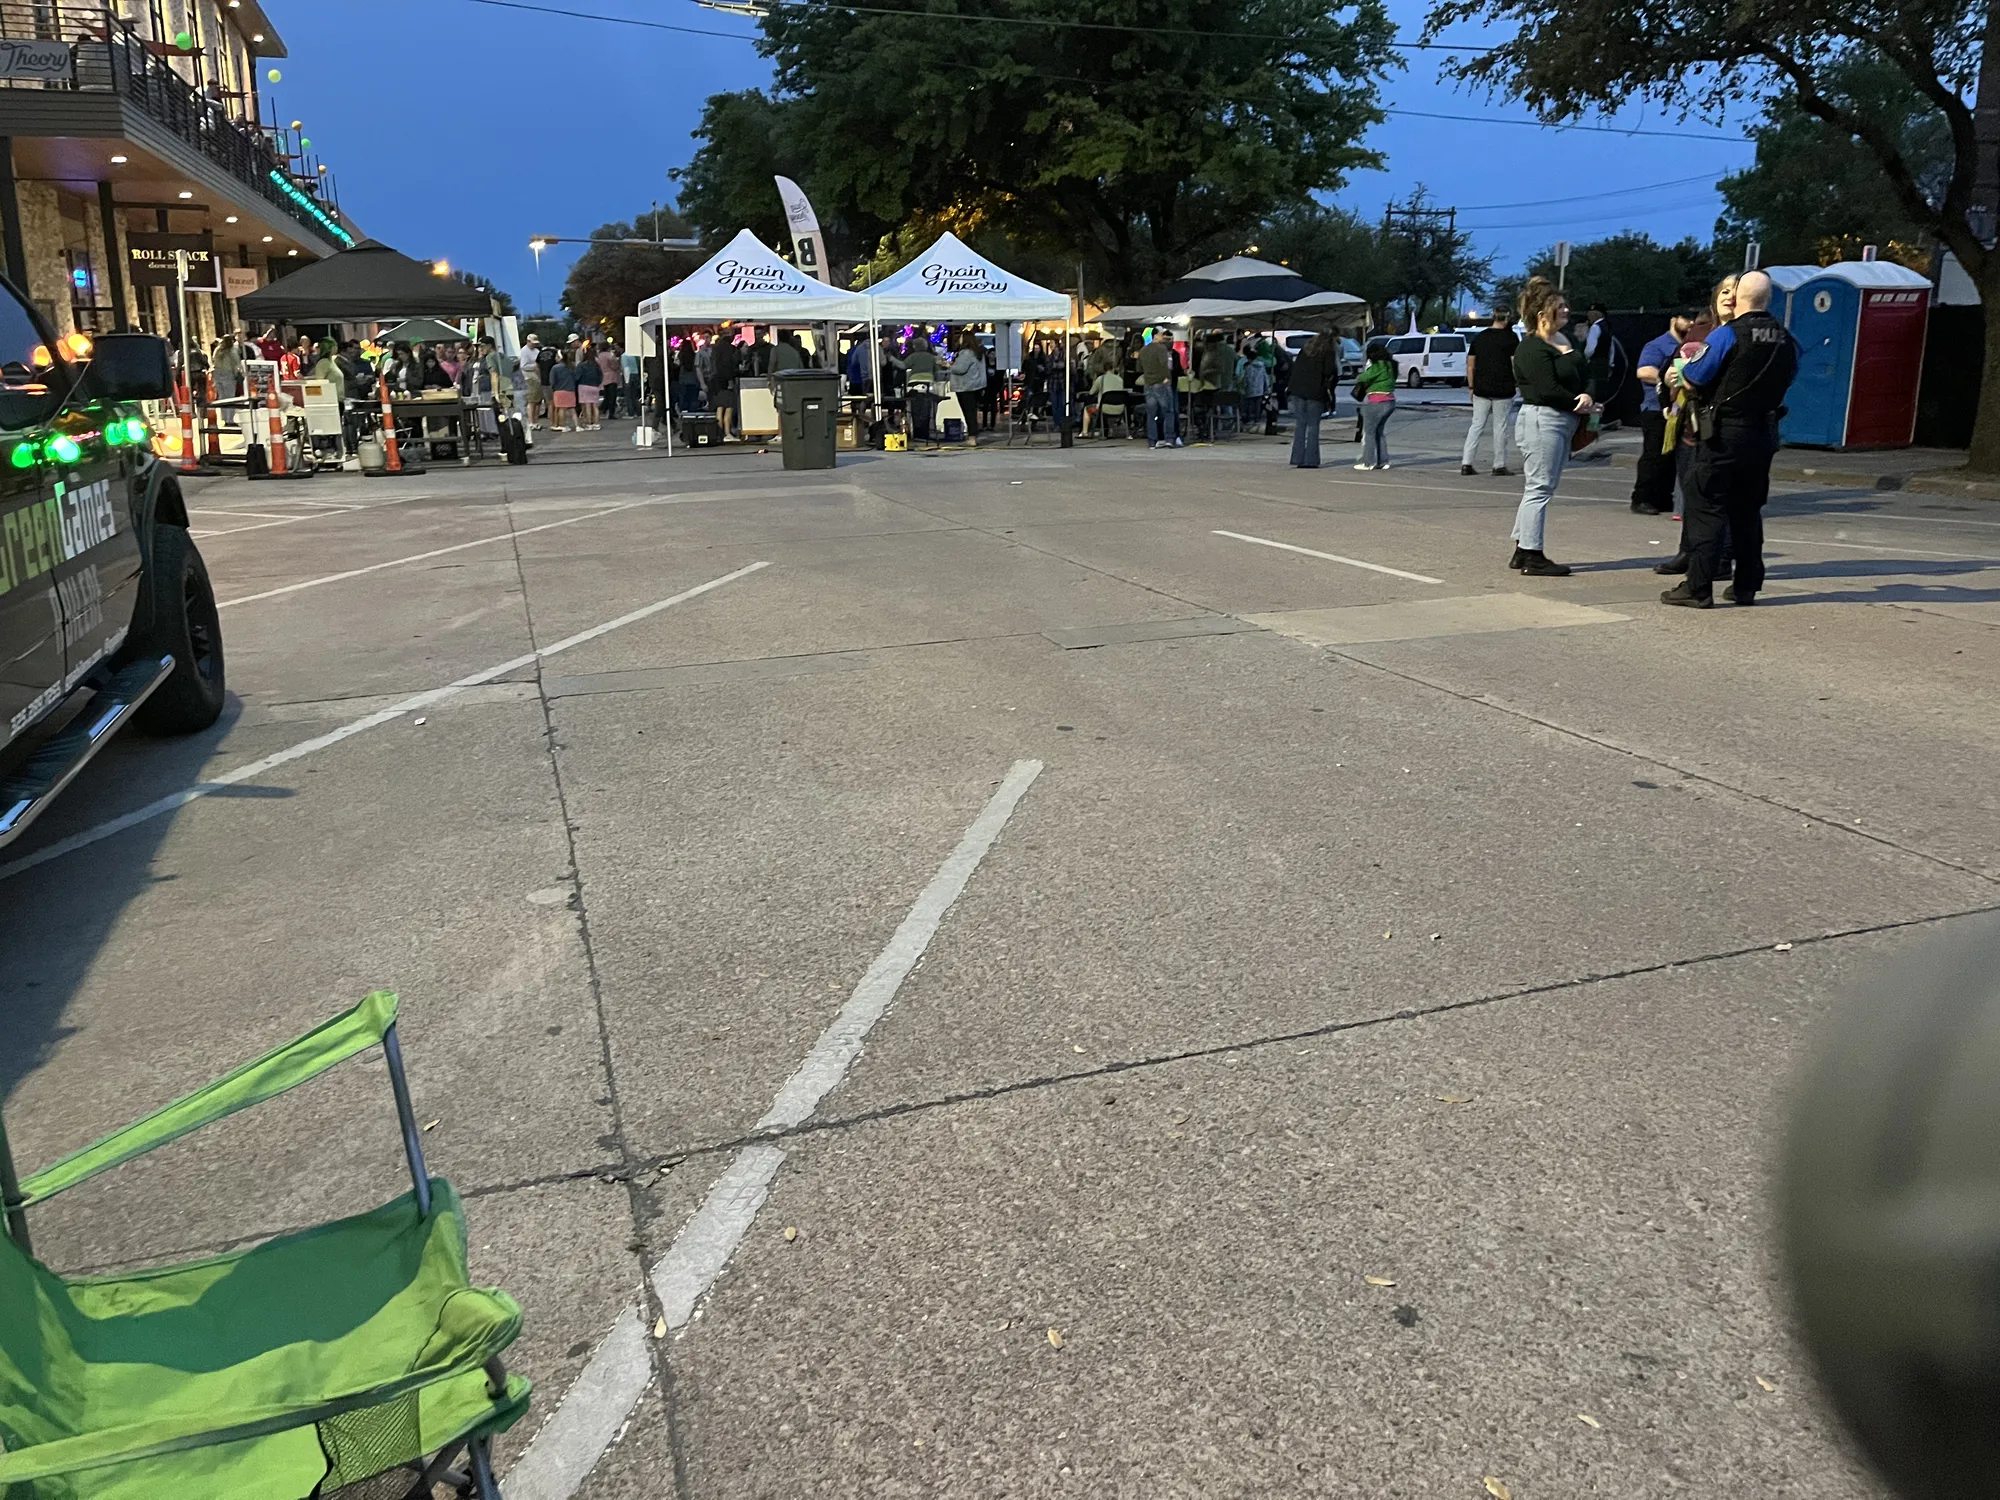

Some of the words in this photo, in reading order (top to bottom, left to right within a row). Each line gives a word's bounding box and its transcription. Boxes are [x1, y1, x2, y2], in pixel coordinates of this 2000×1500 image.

[1, 42, 68, 73] Theory
[131, 248, 166, 260] ROLL
[167, 250, 209, 262] SACK
[716, 259, 785, 284] Grain
[921, 264, 988, 287] Grain
[730, 278, 806, 294] Theory
[937, 279, 1008, 294] Theory
